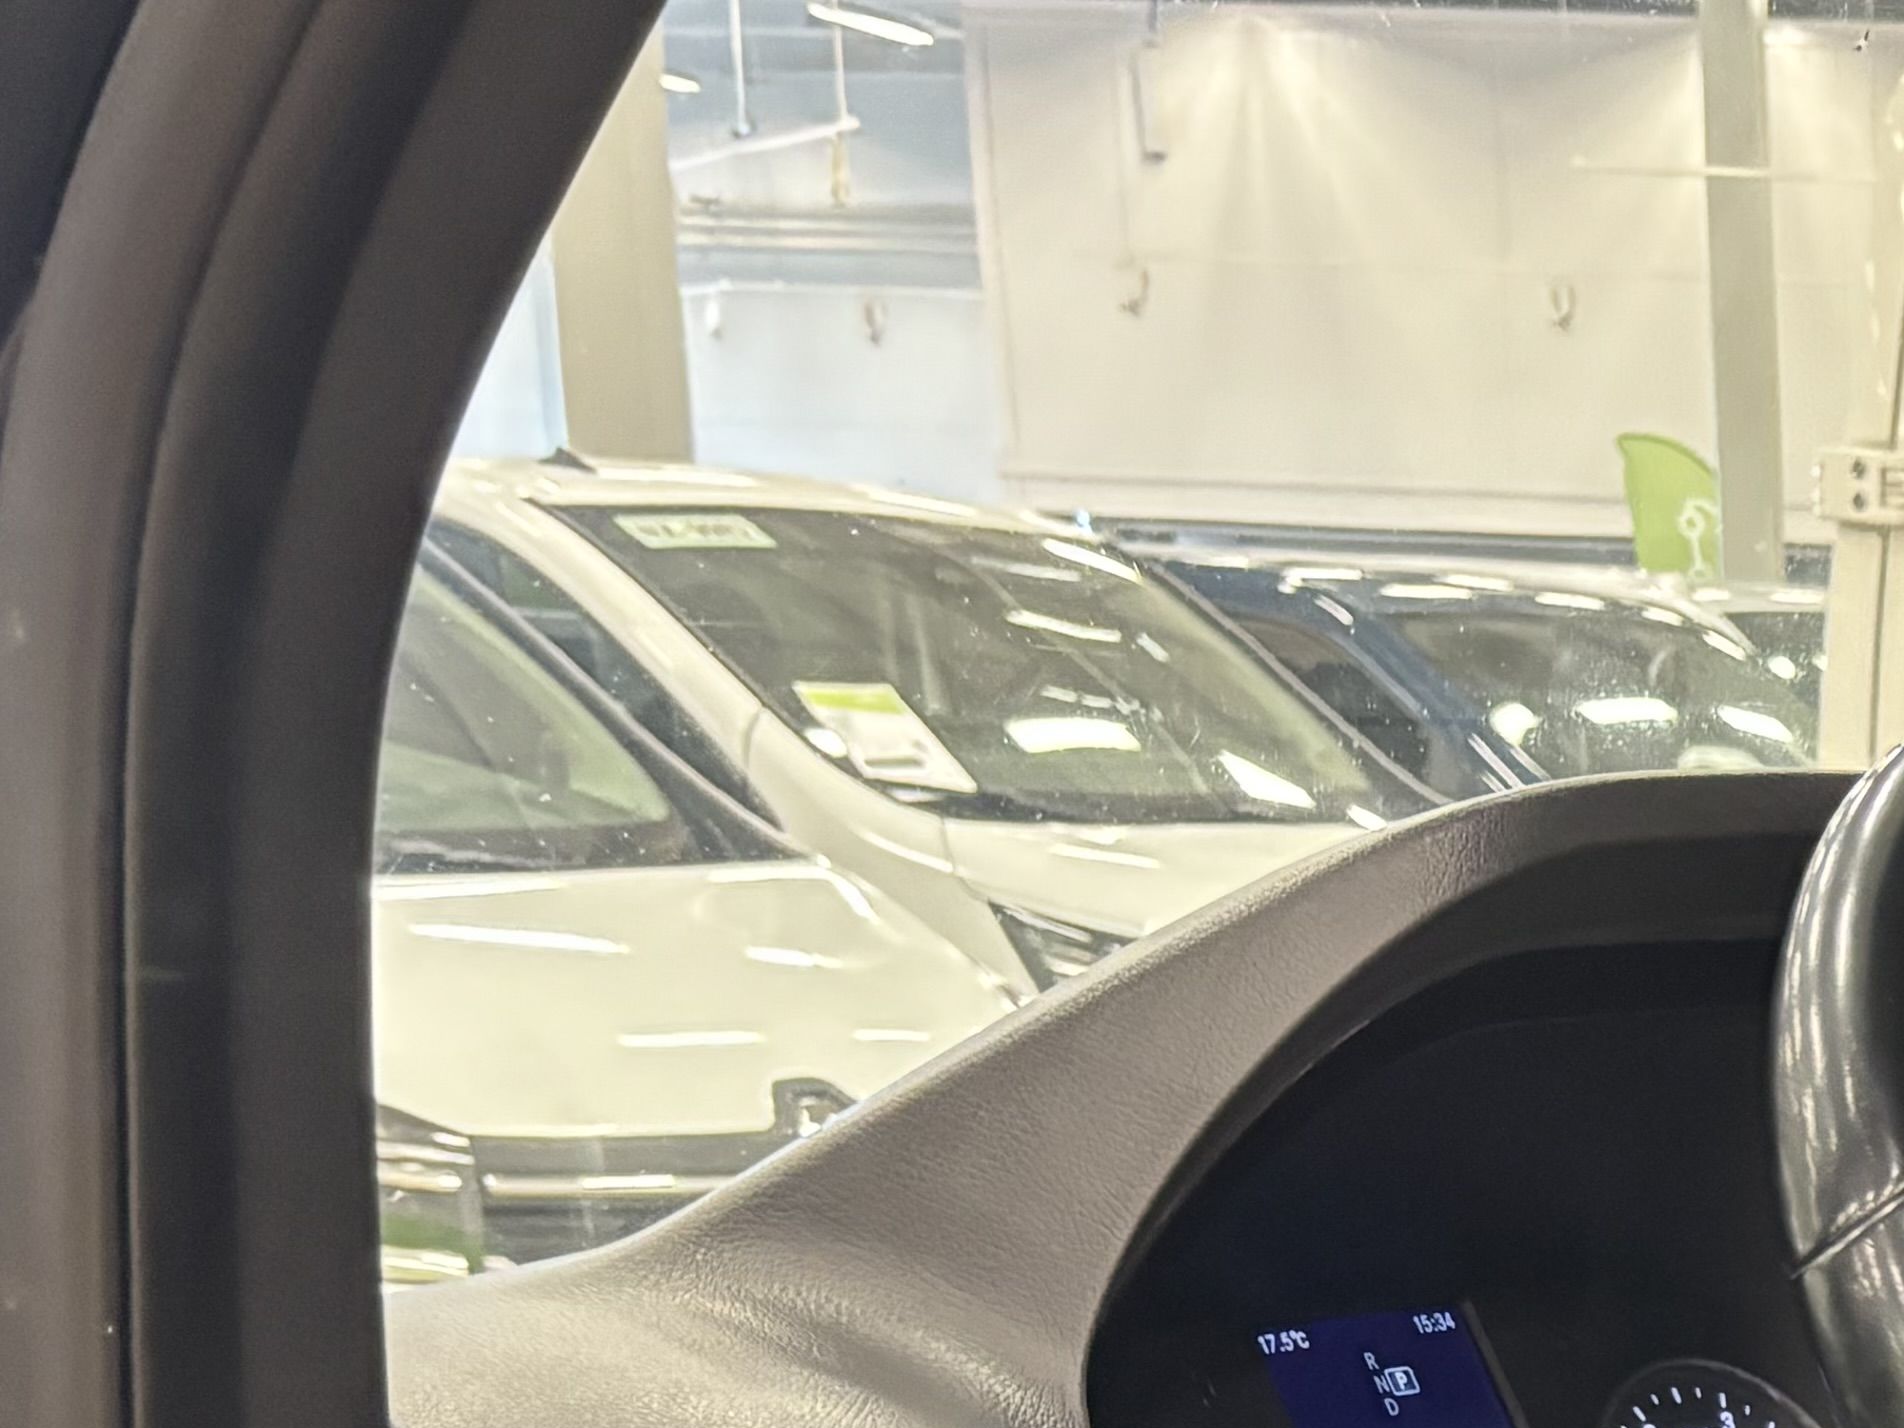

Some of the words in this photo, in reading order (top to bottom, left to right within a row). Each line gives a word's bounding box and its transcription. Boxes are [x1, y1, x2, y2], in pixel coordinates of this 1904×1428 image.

[1413, 1312, 1456, 1334] 15:34
[1363, 1352, 1379, 1369] R
[1373, 1375, 1389, 1394] N
[1395, 1371, 1408, 1391] P
[1384, 1398, 1399, 1416] D
